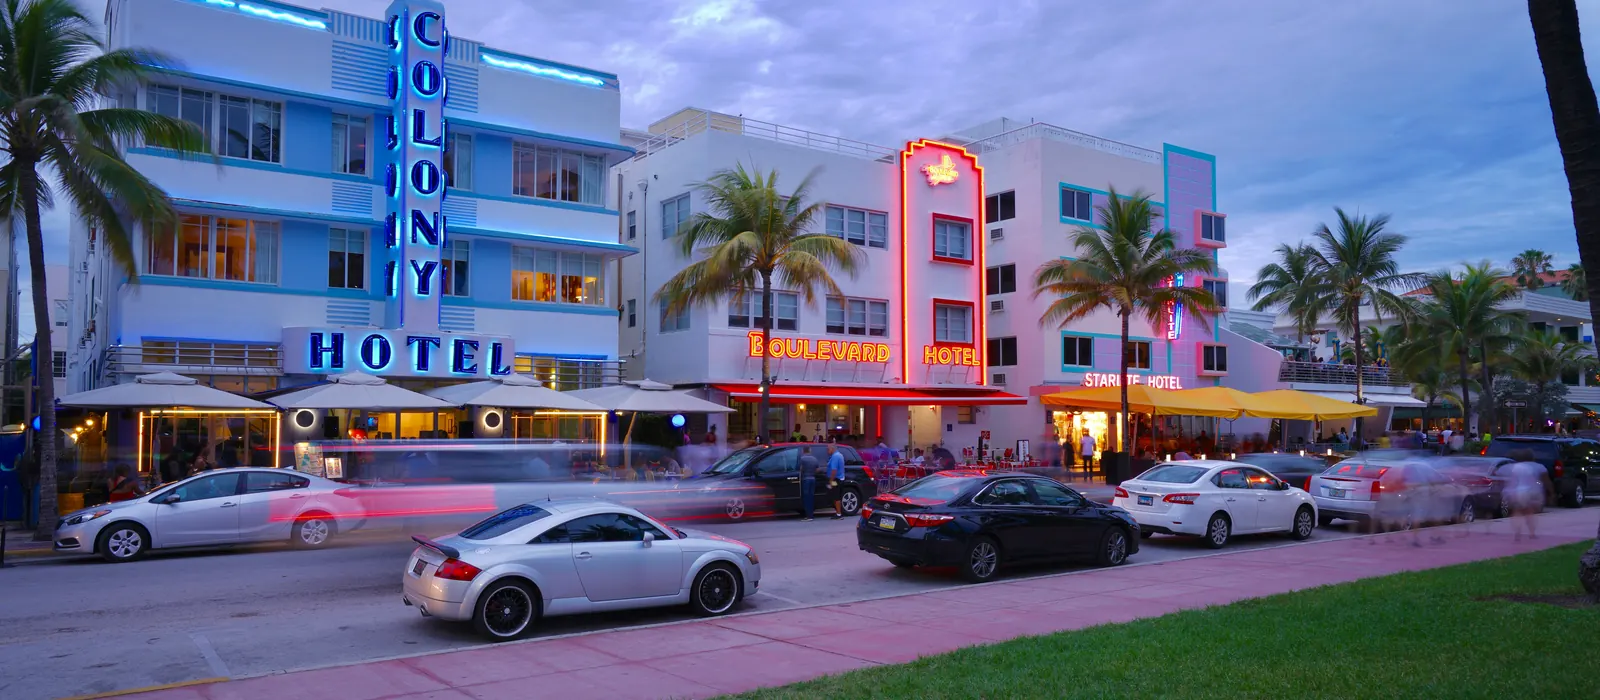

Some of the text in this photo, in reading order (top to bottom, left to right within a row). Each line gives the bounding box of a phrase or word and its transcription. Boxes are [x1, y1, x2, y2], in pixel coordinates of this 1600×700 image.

[411, 11, 441, 296] COLONY
[309, 332, 511, 375] HOTEL
[748, 331, 981, 366] BOULEVARD HOTEL
[1085, 372, 1183, 390] STARLTE HOTEL
